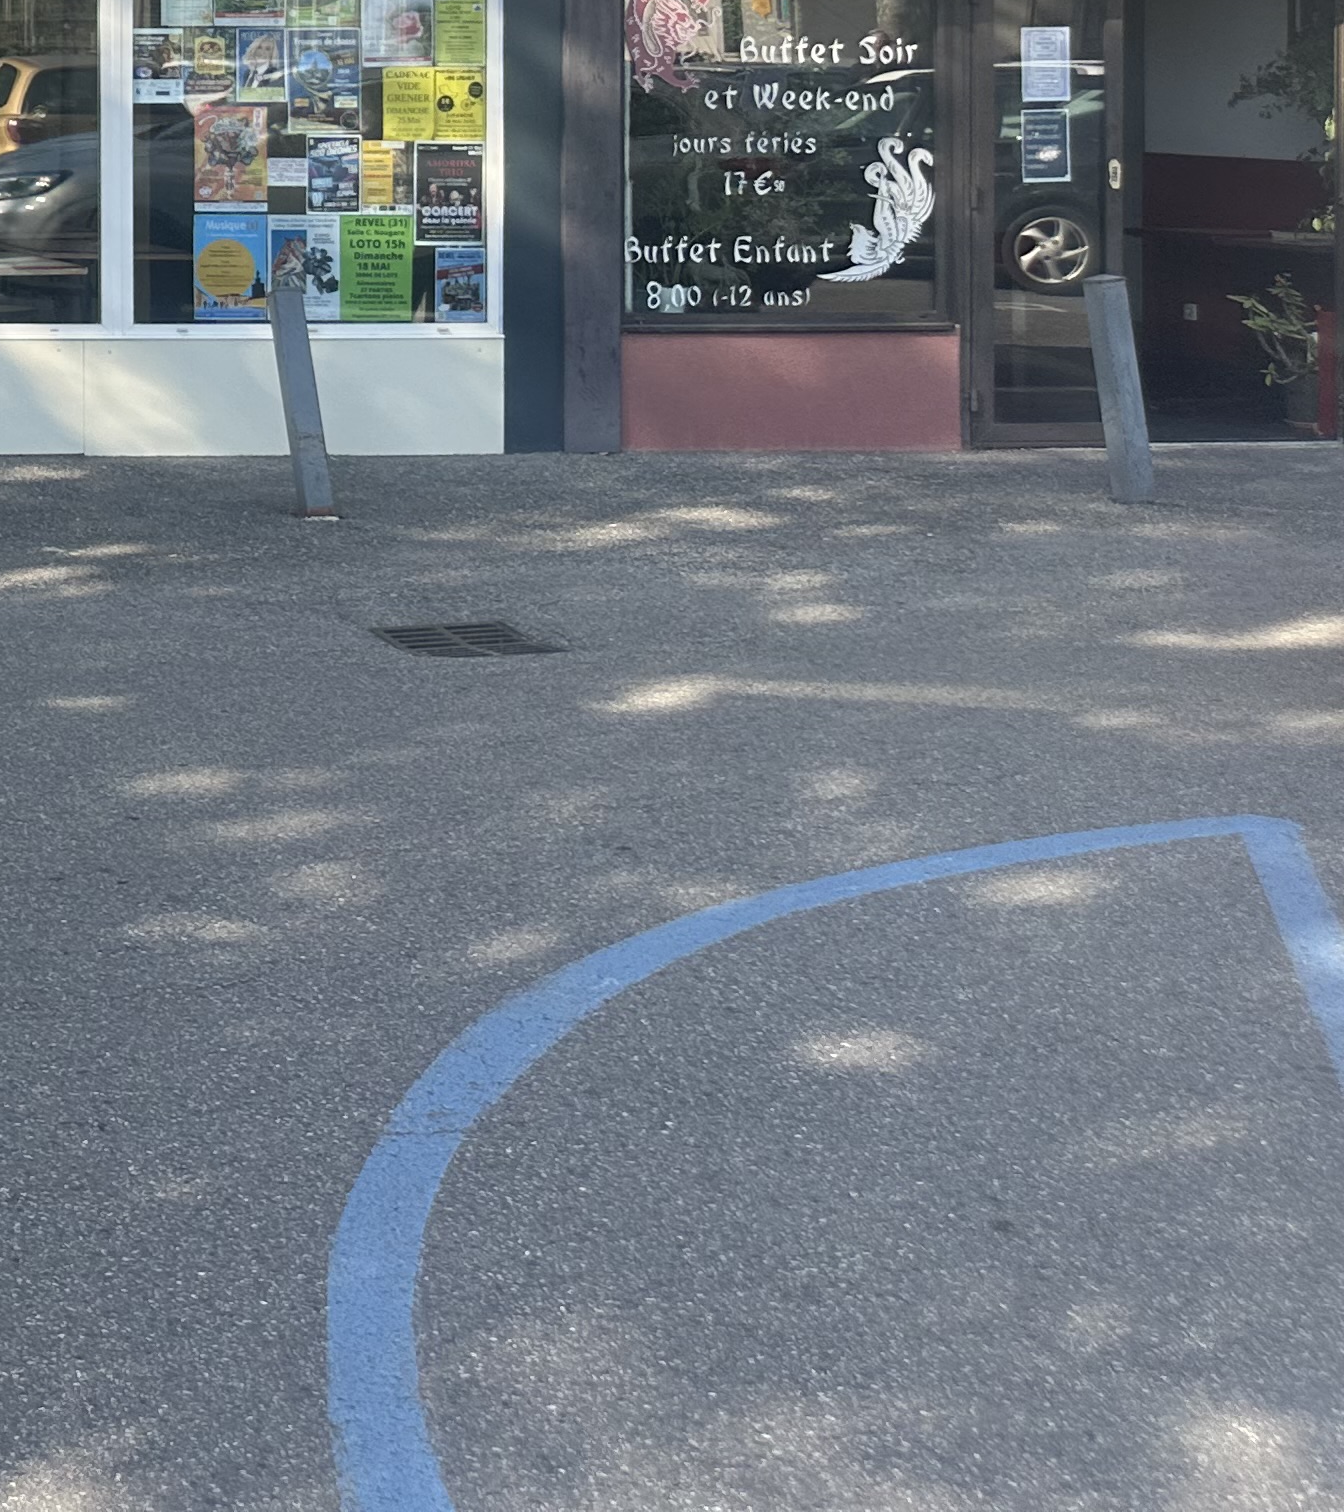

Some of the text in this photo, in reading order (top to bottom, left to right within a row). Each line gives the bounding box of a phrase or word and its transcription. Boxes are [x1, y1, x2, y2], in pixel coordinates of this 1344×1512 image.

[740, 36, 919, 65] Buffet Soir
[397, 82, 421, 90] VIDE
[387, 93, 431, 102] GRENIER
[704, 82, 895, 112] et Week-end
[672, 131, 818, 157] jours féries
[421, 205, 478, 216] CONCERT
[355, 218, 408, 228] REVEL (31)
[349, 239, 406, 249] LOTO 15h
[624, 236, 834, 264] Buffet Enfant
[353, 252, 404, 260] Dimanche
[371, 262, 391, 270] MAI
[646, 281, 811, 311] 8,00 (-12 ans)
